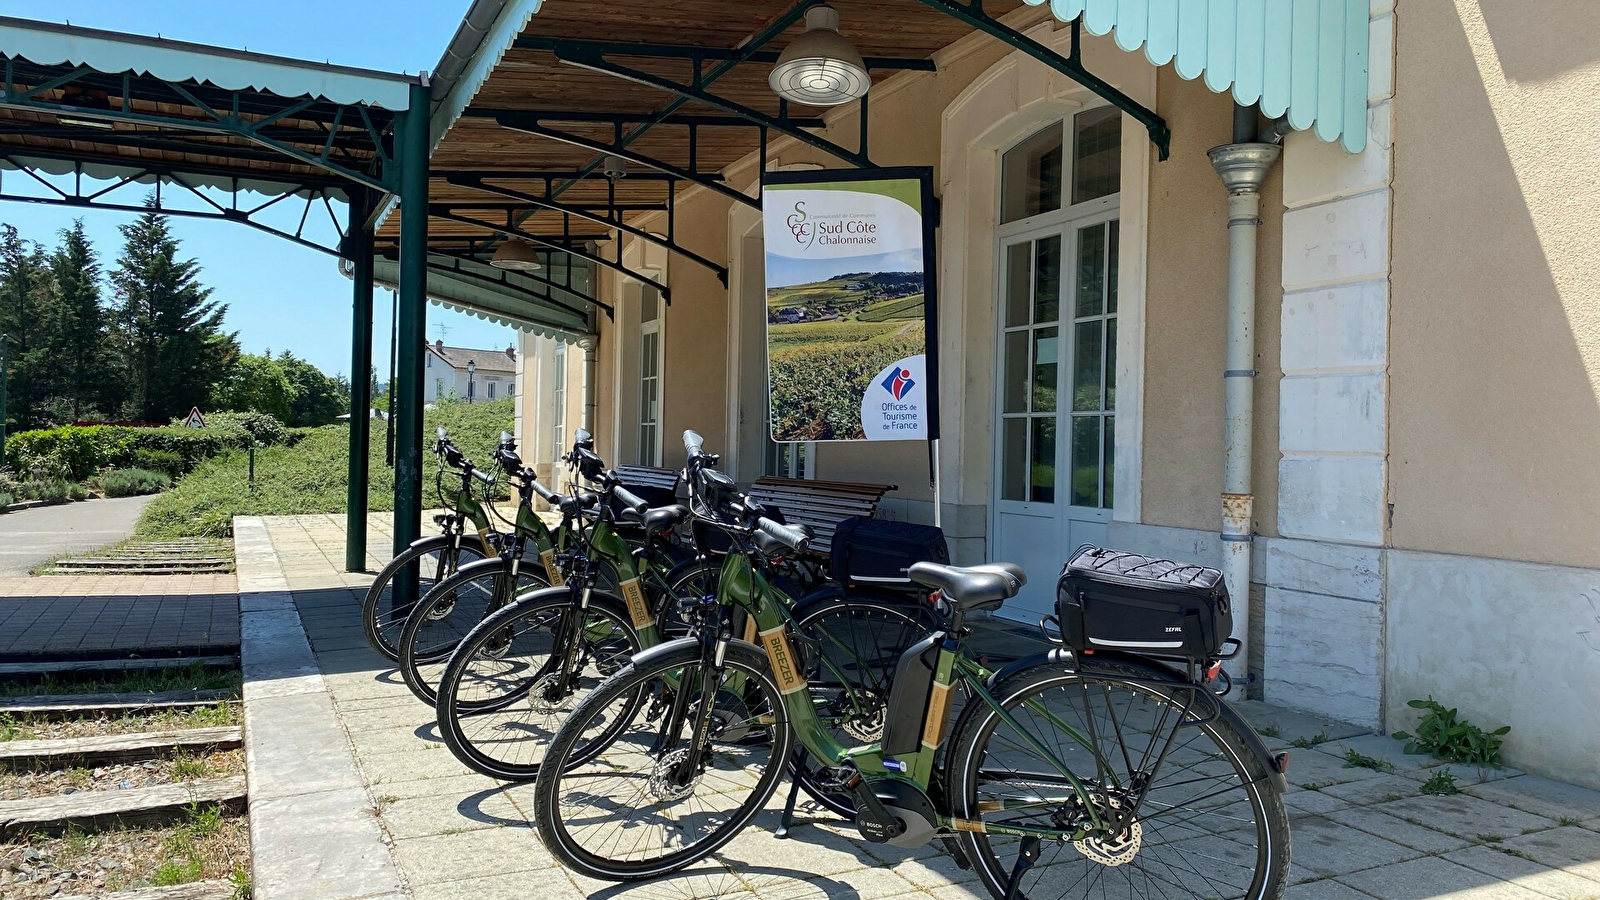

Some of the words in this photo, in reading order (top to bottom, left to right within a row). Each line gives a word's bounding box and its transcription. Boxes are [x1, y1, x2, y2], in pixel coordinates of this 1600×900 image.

[819, 221, 843, 235] Sud
[846, 220, 877, 234] Côte
[818, 235, 877, 246] Chalonnaise
[881, 402, 908, 411] Offices
[882, 412, 917, 421] Tourisme
[891, 421, 918, 430] France
[628, 586, 646, 622] BREEZER
[770, 636, 795, 685] BREEZER
